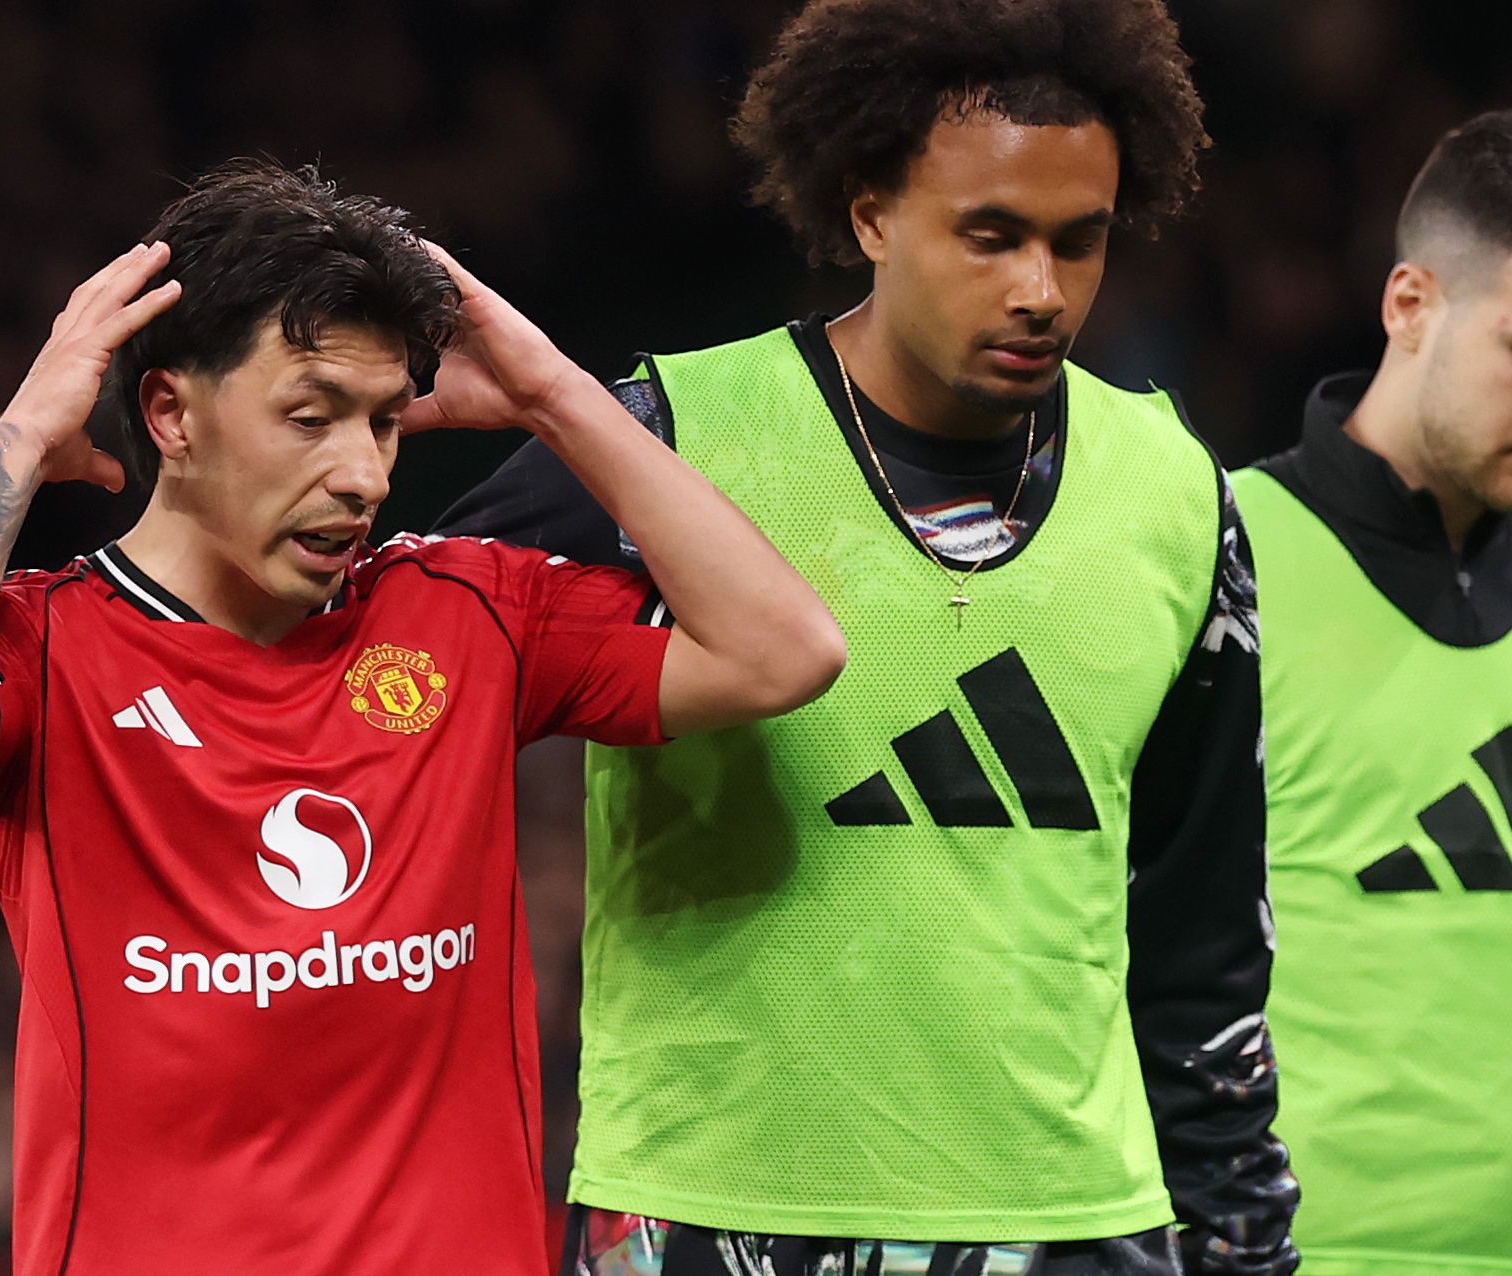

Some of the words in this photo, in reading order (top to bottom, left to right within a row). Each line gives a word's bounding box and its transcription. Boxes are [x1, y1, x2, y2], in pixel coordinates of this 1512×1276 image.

[353, 650, 427, 689] MANCHESTER
[386, 705, 438, 729] UNITED
[123, 922, 476, 1009] Snapdragon
